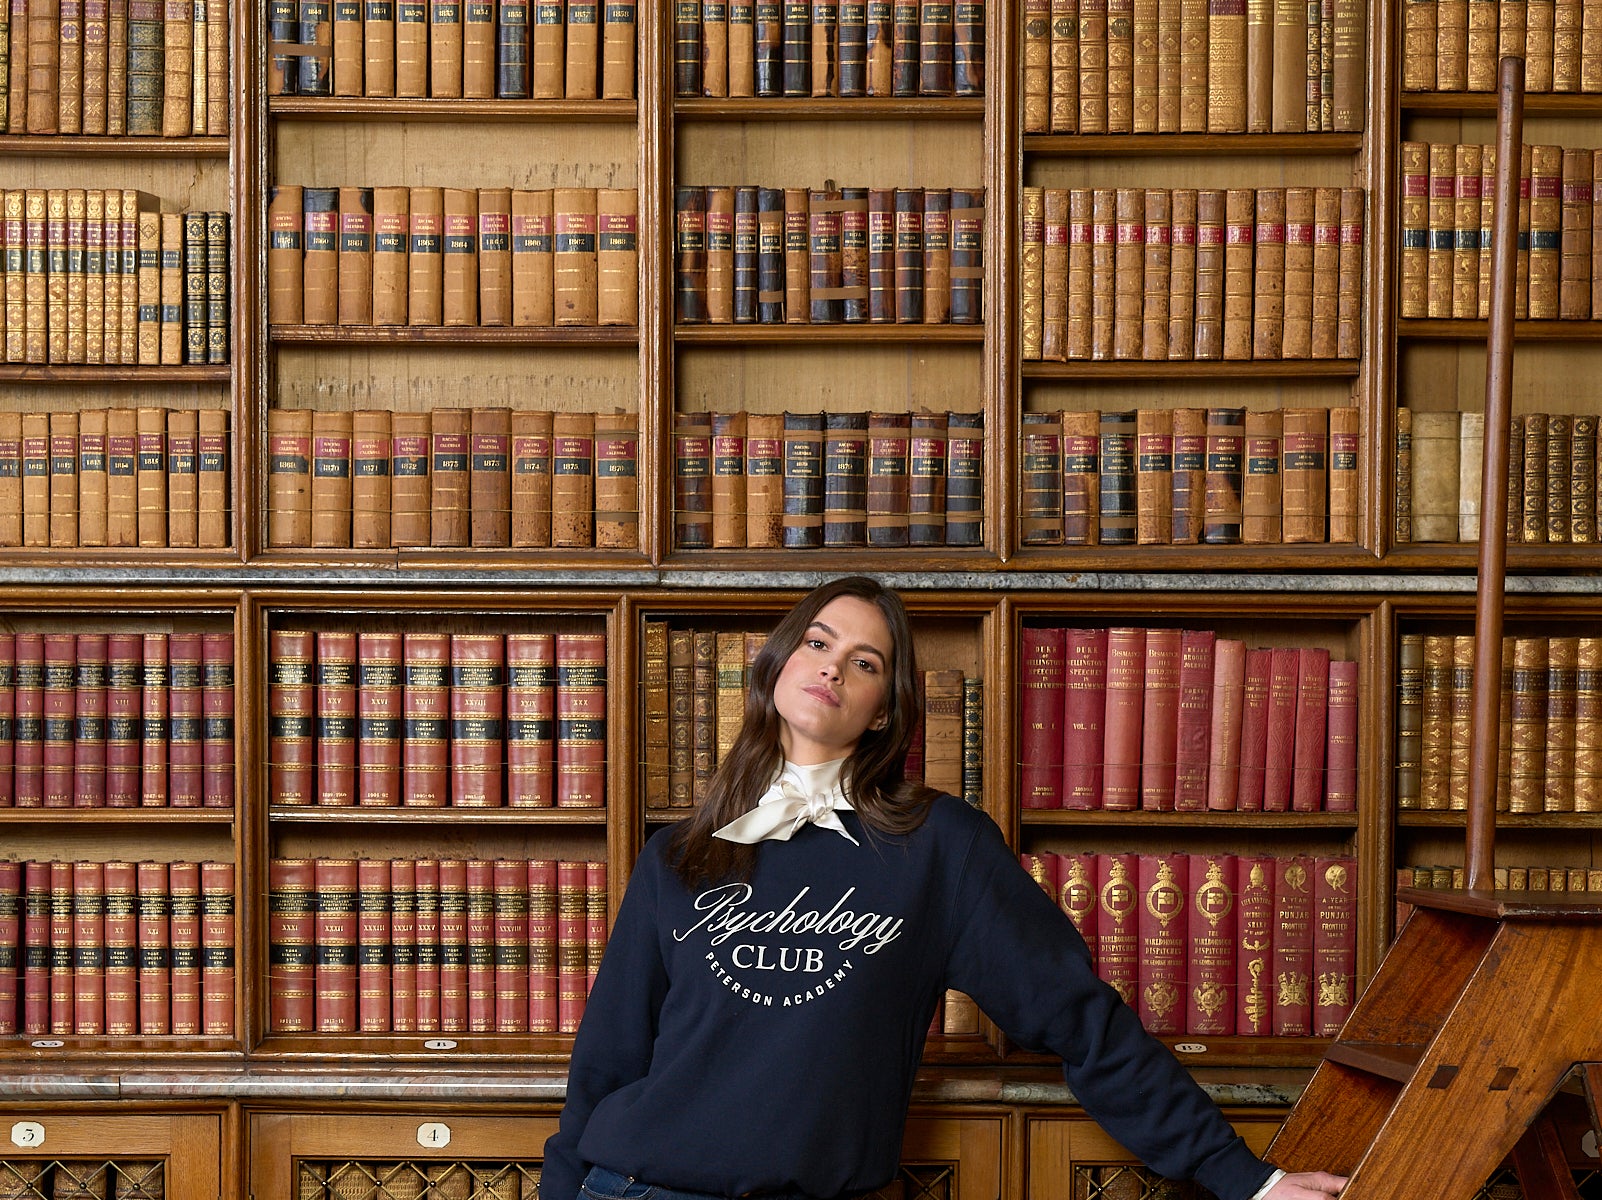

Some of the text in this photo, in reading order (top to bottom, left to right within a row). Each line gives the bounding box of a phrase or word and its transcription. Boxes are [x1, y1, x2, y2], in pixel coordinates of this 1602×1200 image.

[673, 882, 904, 955] Psychology
[1280, 911, 1309, 919] PUNJAB
[1320, 911, 1350, 919] PUNJAB
[732, 944, 824, 973] CLUB
[705, 951, 853, 1007] PETERSON ACADEMY
[427, 1129, 439, 1141] 4
